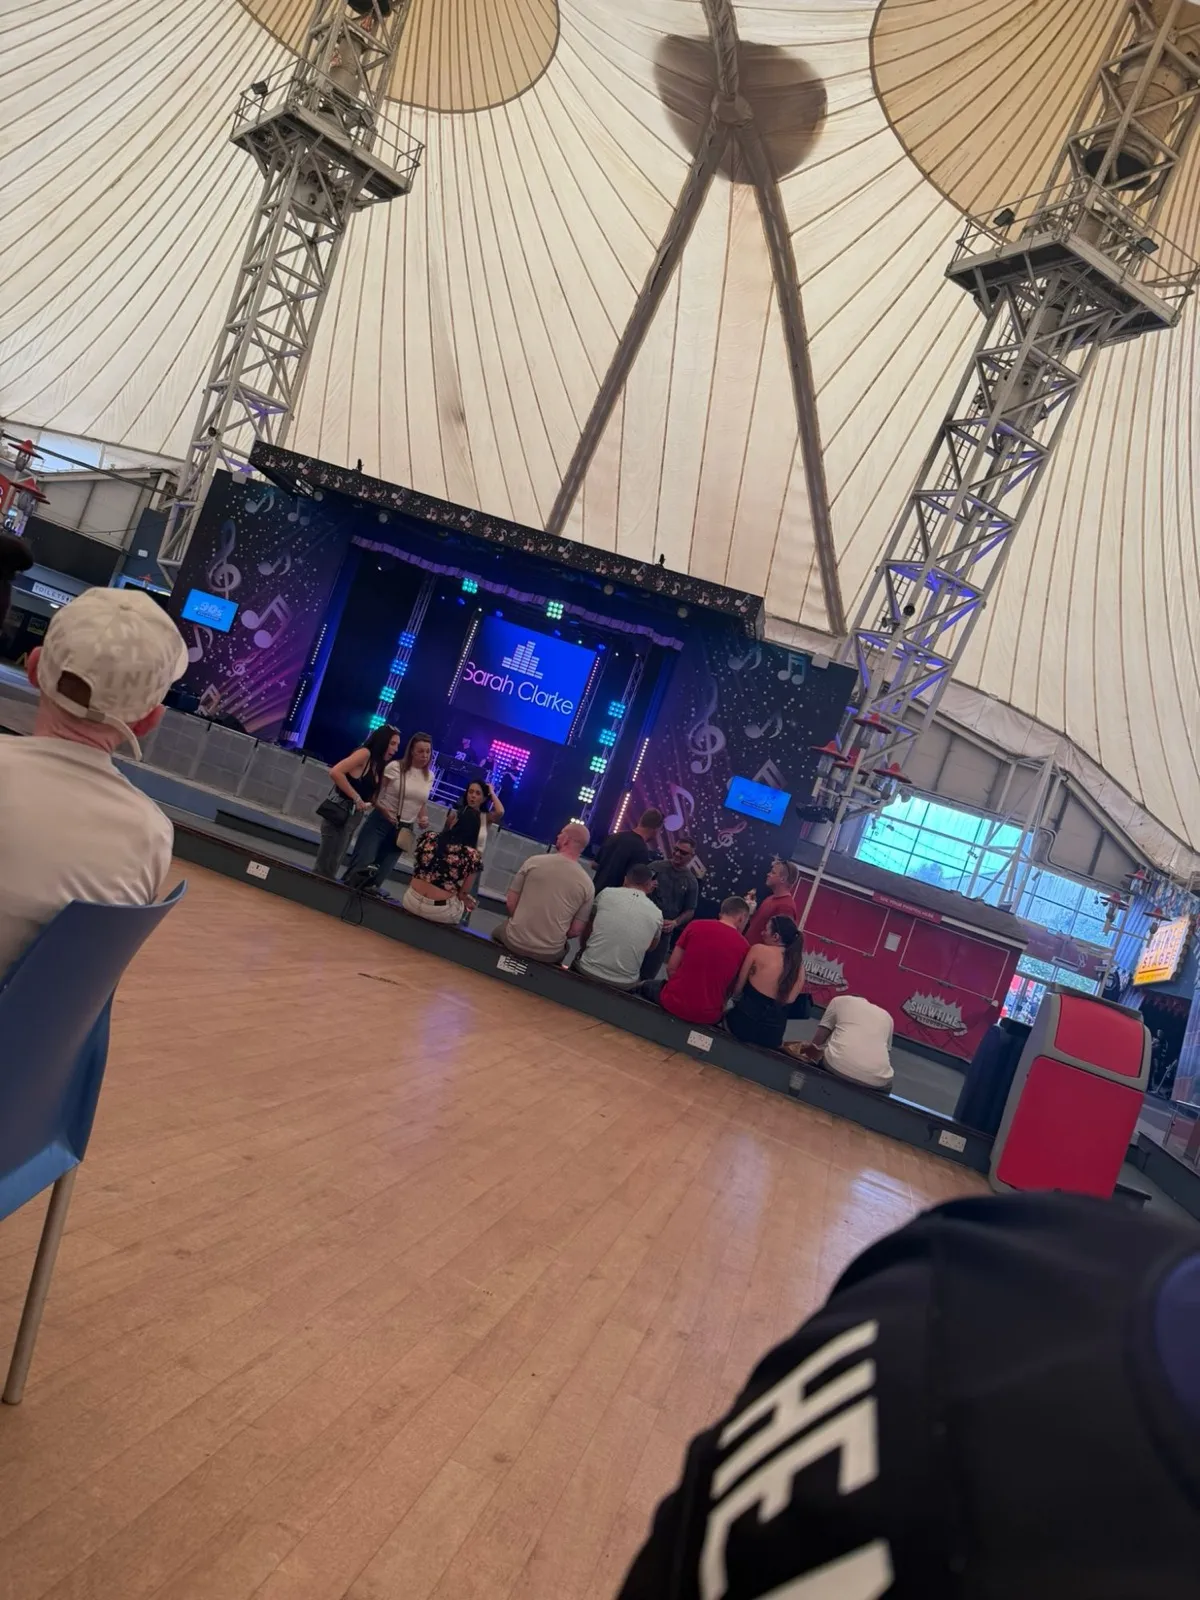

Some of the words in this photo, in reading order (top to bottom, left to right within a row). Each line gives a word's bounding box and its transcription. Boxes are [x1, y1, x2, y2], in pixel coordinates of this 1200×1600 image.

[34, 584, 65, 600] TOILETS
[463, 661, 514, 695] Sarah
[518, 681, 573, 715] Clarke
[803, 960, 841, 983] OWTIME
[909, 1001, 958, 1027] SHOWTIME
